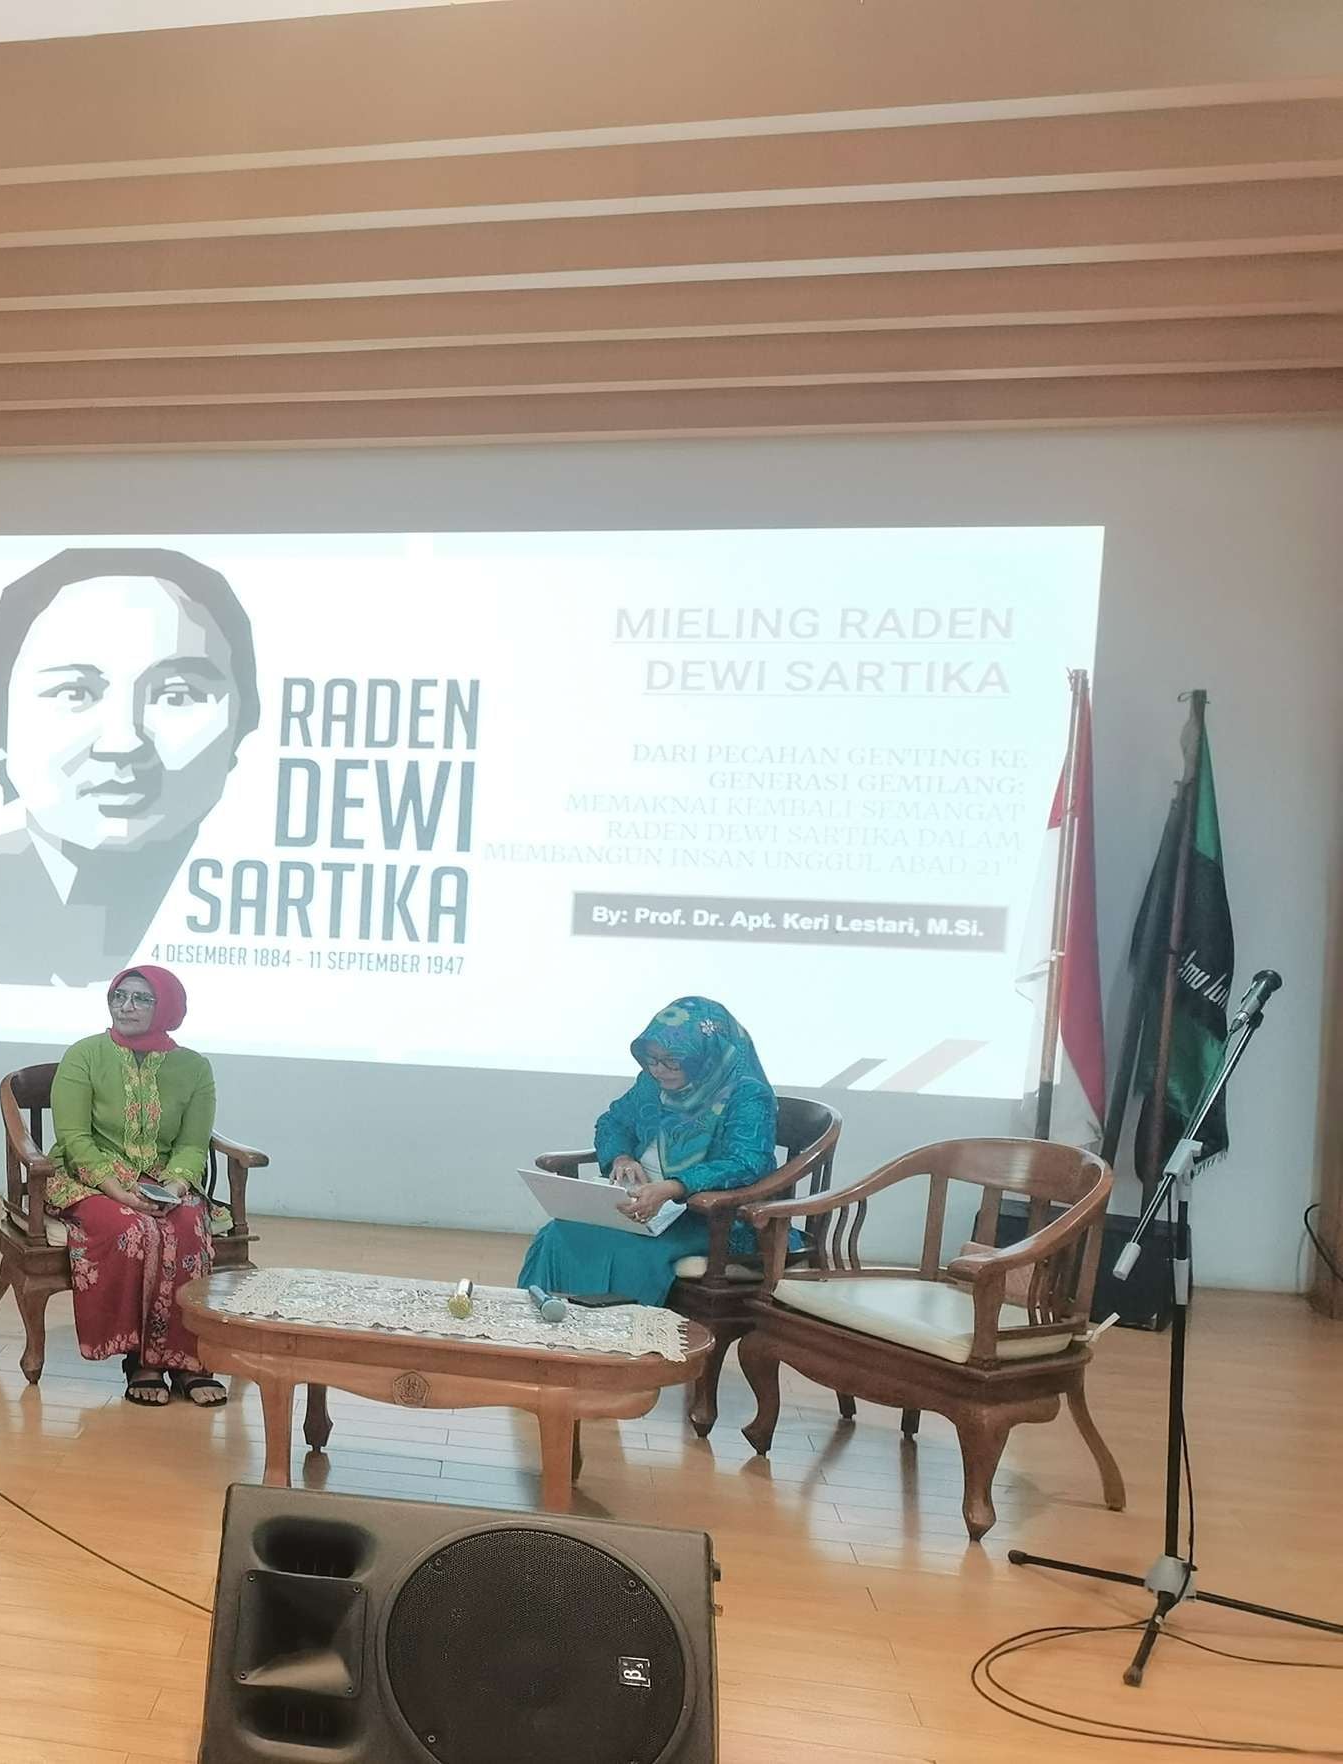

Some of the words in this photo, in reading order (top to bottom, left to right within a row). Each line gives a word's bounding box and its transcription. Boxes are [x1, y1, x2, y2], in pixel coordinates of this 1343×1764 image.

[614, 607, 820, 639] MIELING
[839, 607, 1014, 640] RADEN
[645, 659, 766, 692] DEWI
[784, 660, 1010, 694] SARTIKA
[279, 677, 481, 750] RADEN
[631, 743, 698, 764] DARI
[706, 744, 840, 765] PECAHAN
[847, 747, 981, 768] GENTING
[990, 749, 1029, 769] KE
[708, 770, 849, 792] GENERASI
[856, 773, 1025, 795] GEMILANG:
[274, 757, 476, 853] DEWI
[565, 793, 718, 815] MEMAKNAI
[727, 796, 853, 817] KEMBALI
[862, 799, 1025, 823] SEMANGAT
[607, 819, 698, 841] RADEN
[707, 822, 778, 843] DEWI
[786, 824, 909, 847] SARTIKA
[917, 827, 1023, 850] DALAM
[481, 842, 663, 866] MEMBANGUN
[671, 847, 756, 868] INSAN
[763, 849, 882, 873] UNGGUL
[888, 854, 968, 875] ABAD
[185, 857, 468, 944] SARTIKA
[591, 905, 628, 926] By:
[634, 907, 686, 926] Prof.
[693, 909, 724, 927] Dr.
[730, 910, 776, 932] Apt.
[783, 912, 829, 931] Keri
[836, 915, 921, 937] Lestari,
[926, 918, 985, 937] M.Si.
[150, 943, 160, 961] 4
[165, 944, 248, 966] DESEMBER
[253, 948, 292, 968] 1884
[308, 950, 322, 970] 11
[327, 951, 420, 973] SEPTEMBER
[426, 955, 465, 975] 1947
